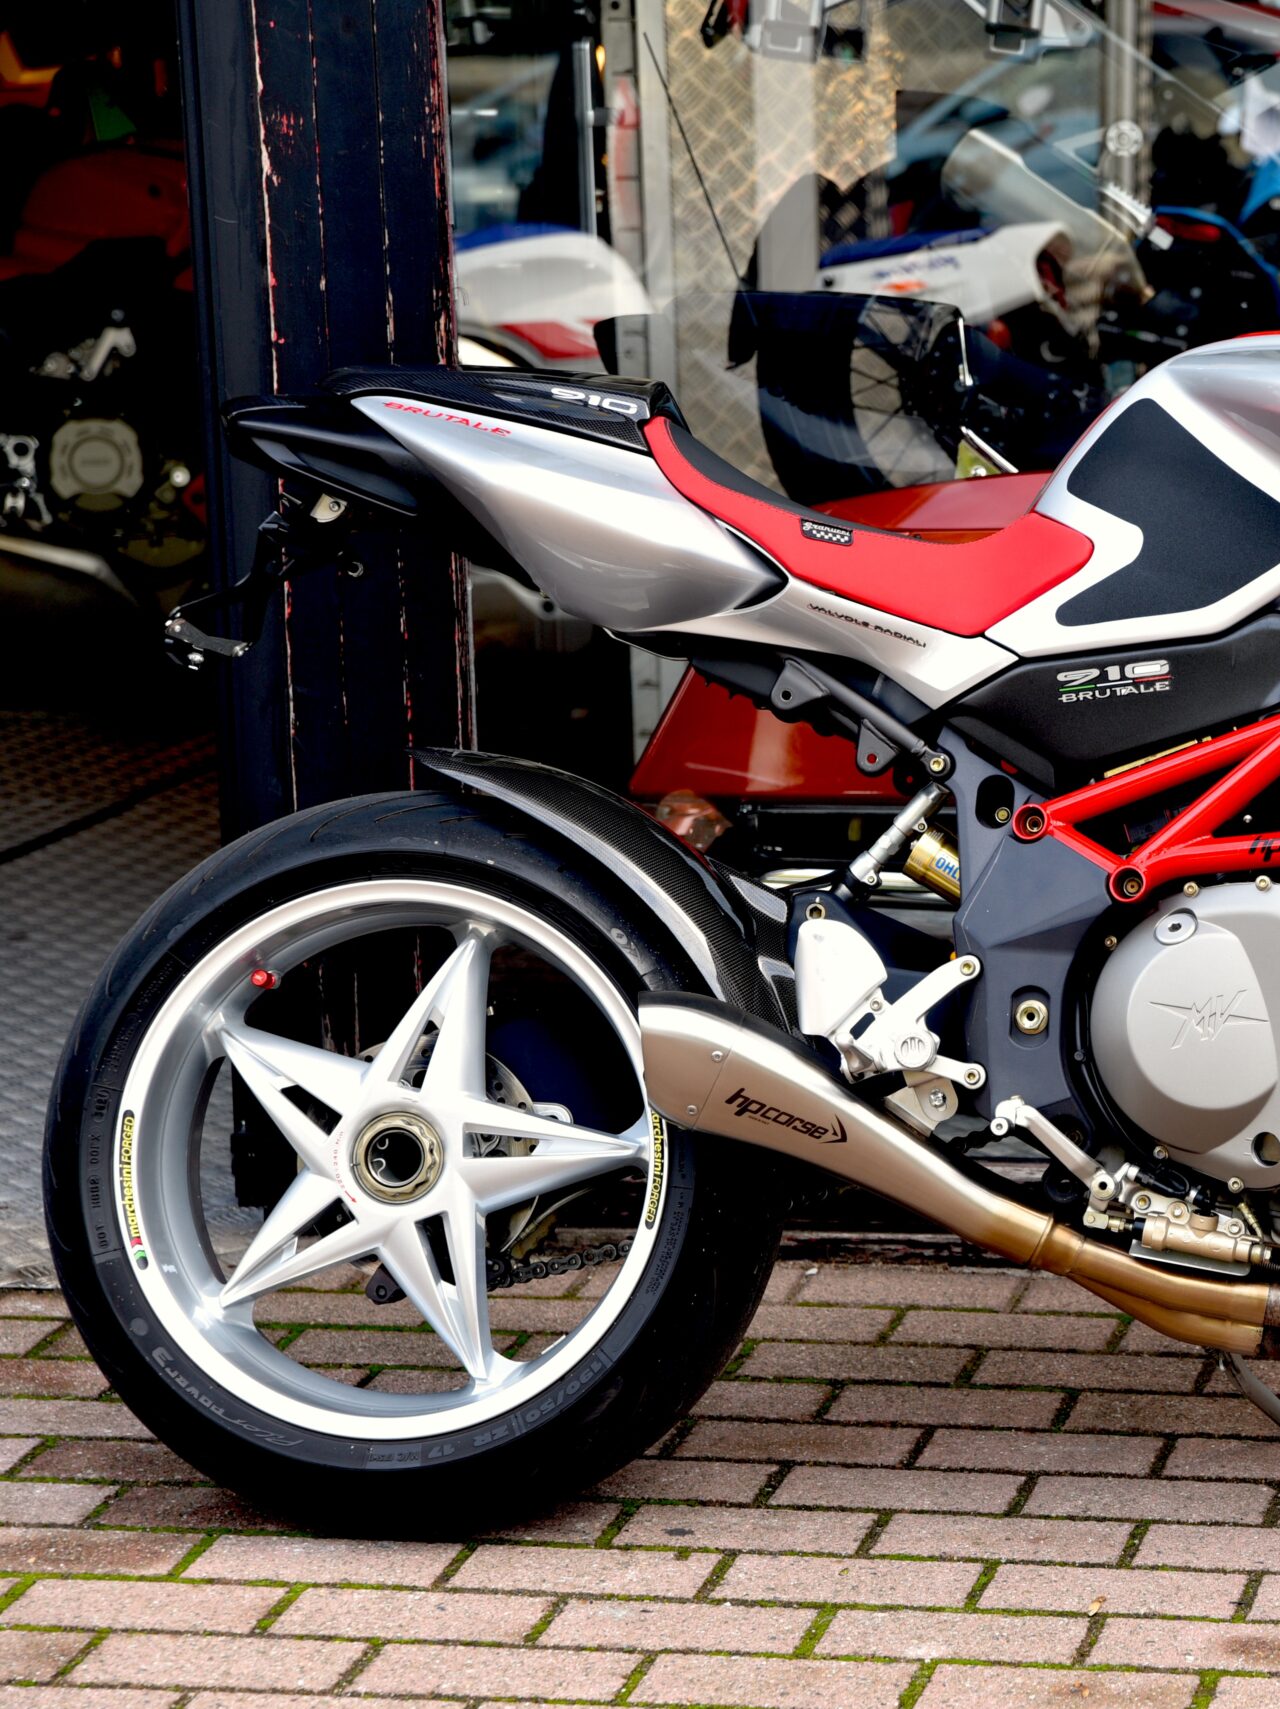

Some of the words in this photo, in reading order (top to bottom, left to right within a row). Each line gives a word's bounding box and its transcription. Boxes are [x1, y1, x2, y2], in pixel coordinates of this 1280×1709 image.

[551, 387, 638, 415] 910
[384, 401, 513, 437] BRUTALE
[808, 603, 870, 628] VALVOLE
[1056, 659, 1170, 688] 910
[1058, 681, 1171, 703] BRUTALE
[121, 1116, 135, 1162] FORGED
[119, 1164, 141, 1238] marchesini
[645, 1176, 663, 1224] FORGED
[522, 1357, 604, 1425] 190/50
[425, 1442, 456, 1458] 17
[470, 1423, 511, 1448] ZR
